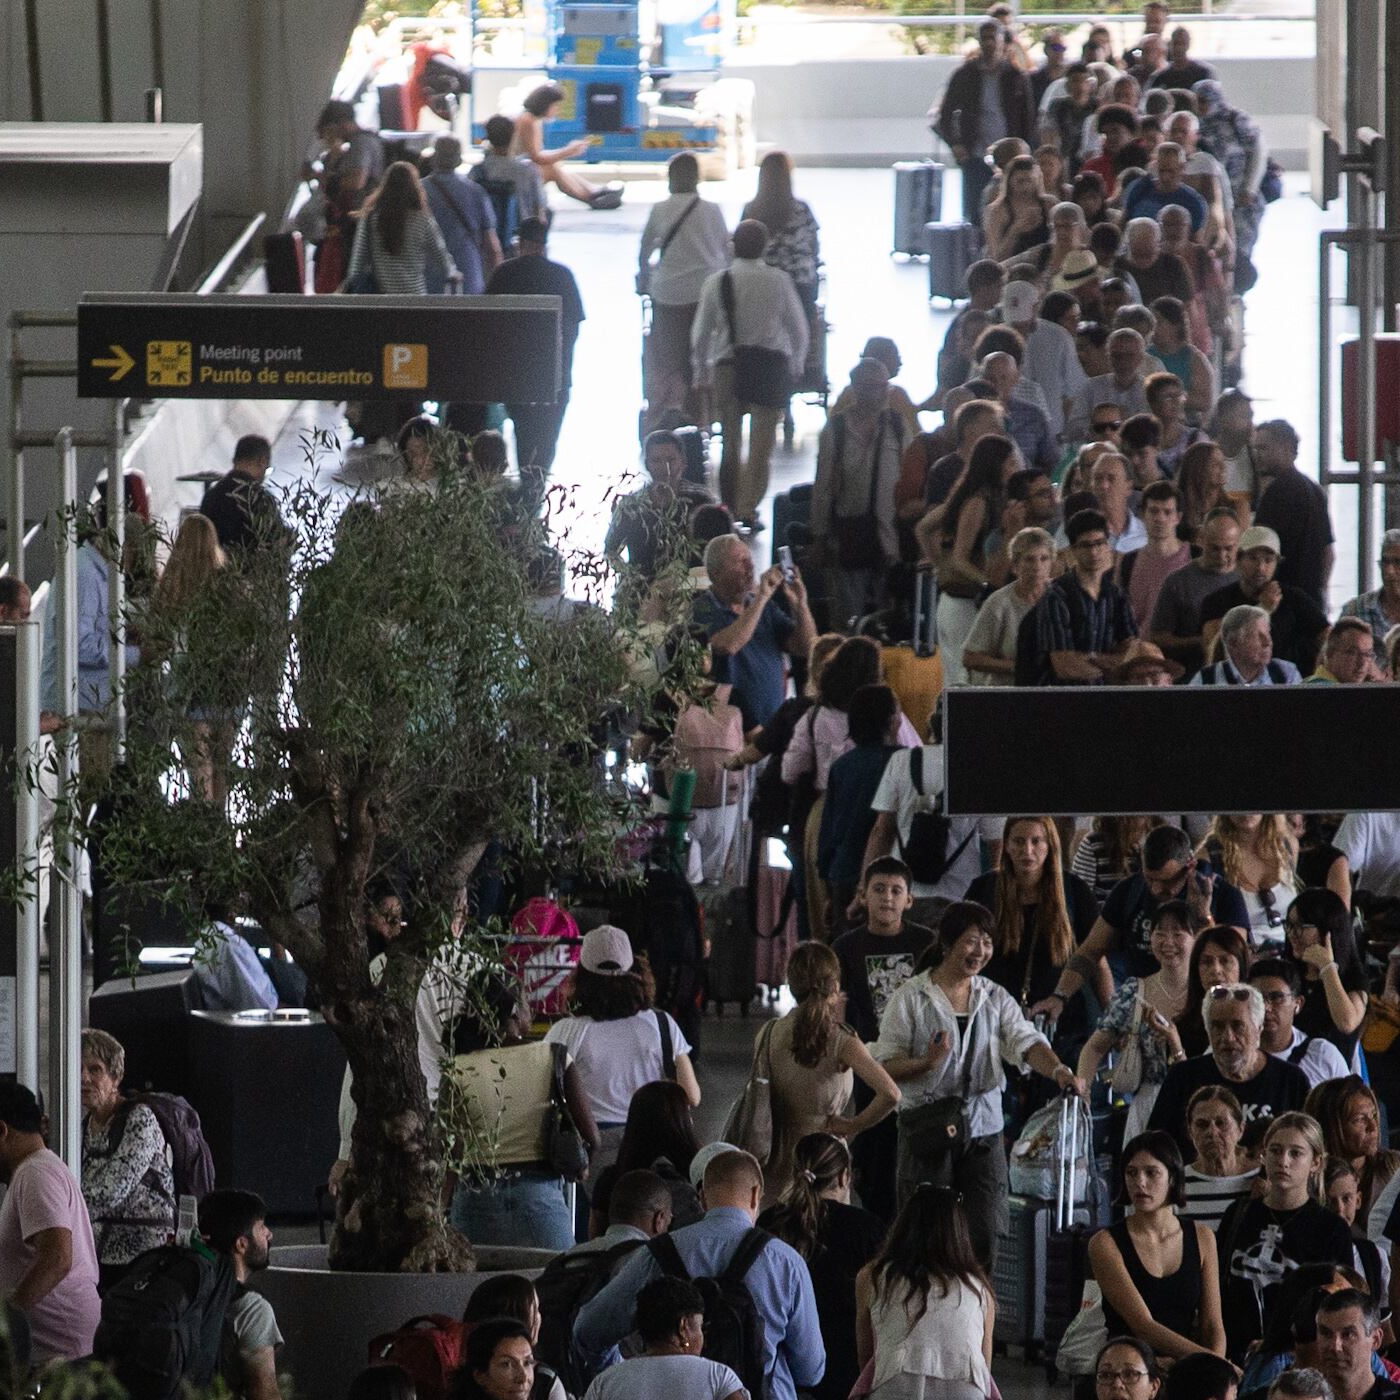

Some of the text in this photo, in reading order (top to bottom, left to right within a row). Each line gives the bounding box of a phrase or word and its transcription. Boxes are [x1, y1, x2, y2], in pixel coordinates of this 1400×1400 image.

[200, 344, 261, 364] Meeting
[264, 344, 303, 364] point
[200, 366, 253, 385] Punto
[257, 366, 281, 385] de
[284, 368, 374, 385] encuentro
